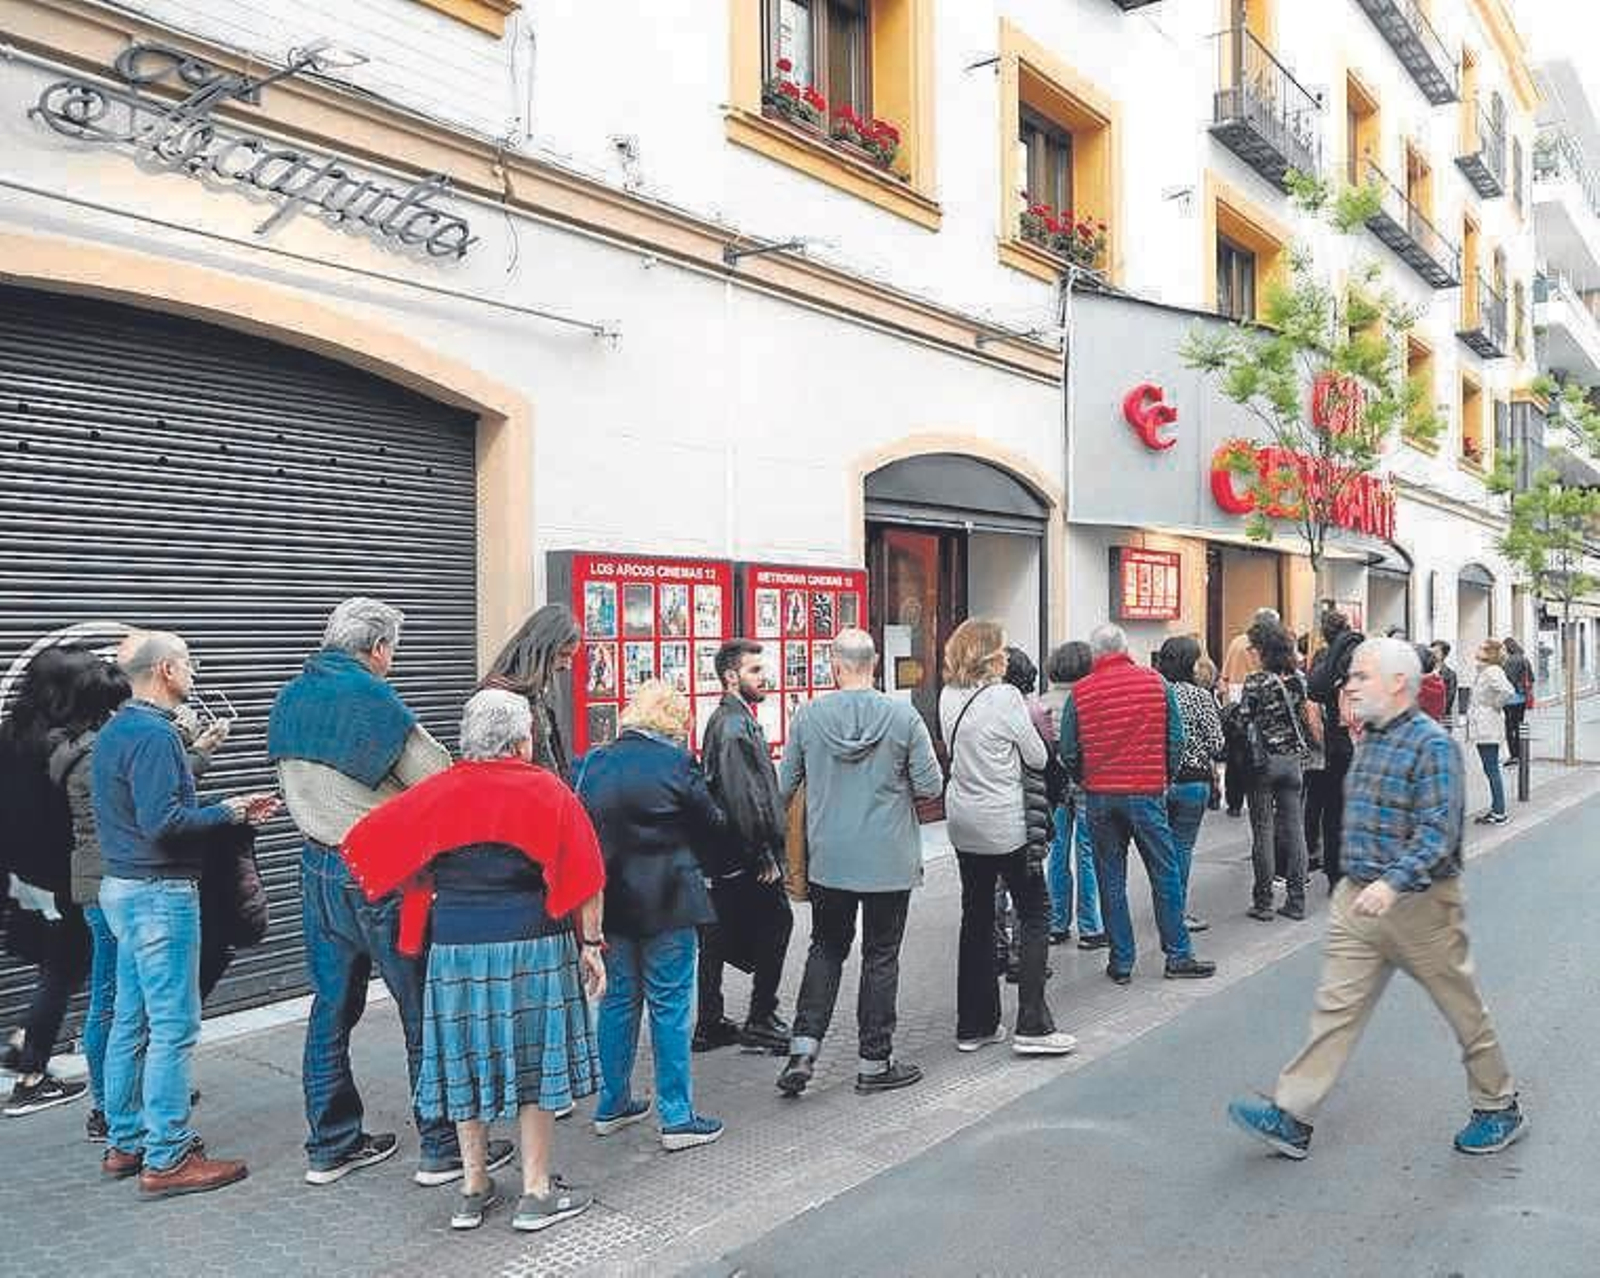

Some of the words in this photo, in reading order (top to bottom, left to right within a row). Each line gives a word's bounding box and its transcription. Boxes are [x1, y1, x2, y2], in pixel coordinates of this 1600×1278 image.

[589, 563, 614, 575] LOS
[615, 563, 655, 577] ARCOS
[656, 565, 703, 579] CINEMAS
